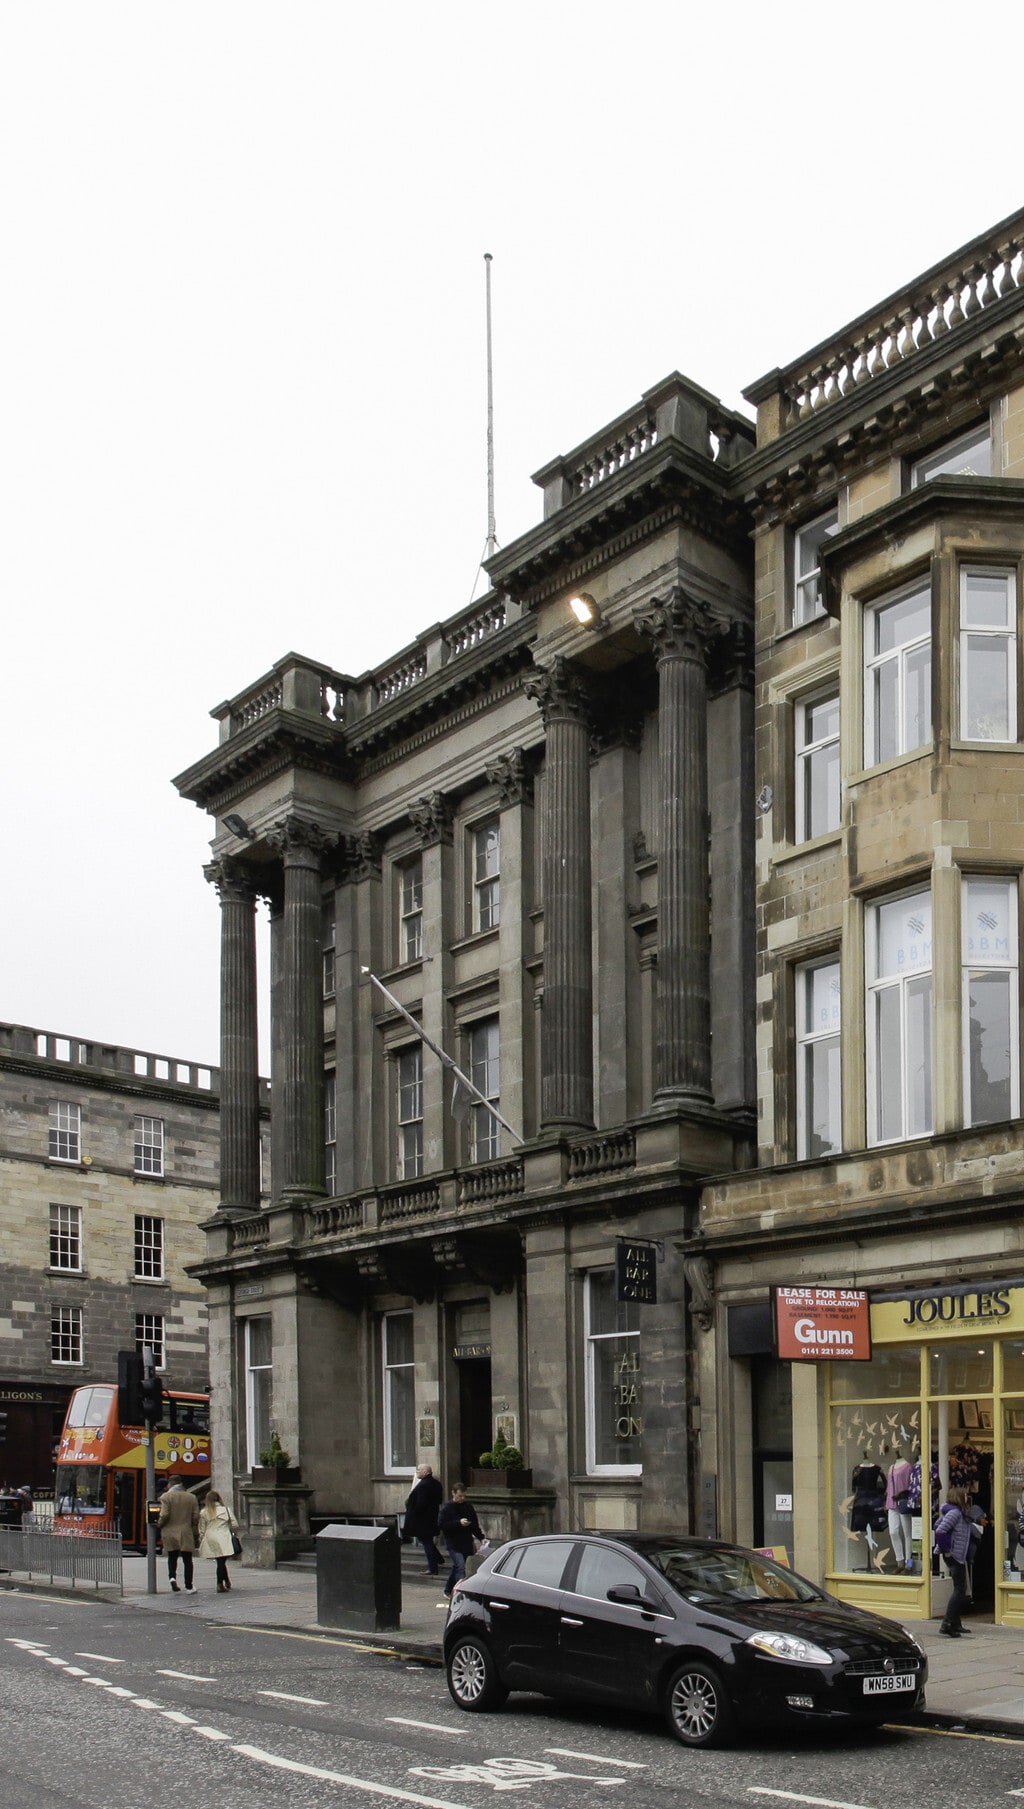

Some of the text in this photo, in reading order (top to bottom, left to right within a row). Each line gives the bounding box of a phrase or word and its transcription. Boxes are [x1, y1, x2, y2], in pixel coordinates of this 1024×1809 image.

[626, 1249, 649, 1262] ALL
[626, 1267, 649, 1280] BAR
[624, 1285, 652, 1299] ONE
[778, 1287, 866, 1300] LEASE FOR SALE
[816, 1300, 859, 1308] RELOCATION)
[903, 1288, 1010, 1324] JOULES
[794, 1318, 854, 1344] Gunn
[1, 1391, 43, 1400] LIGON'S
[868, 1677, 894, 1691] WN58
